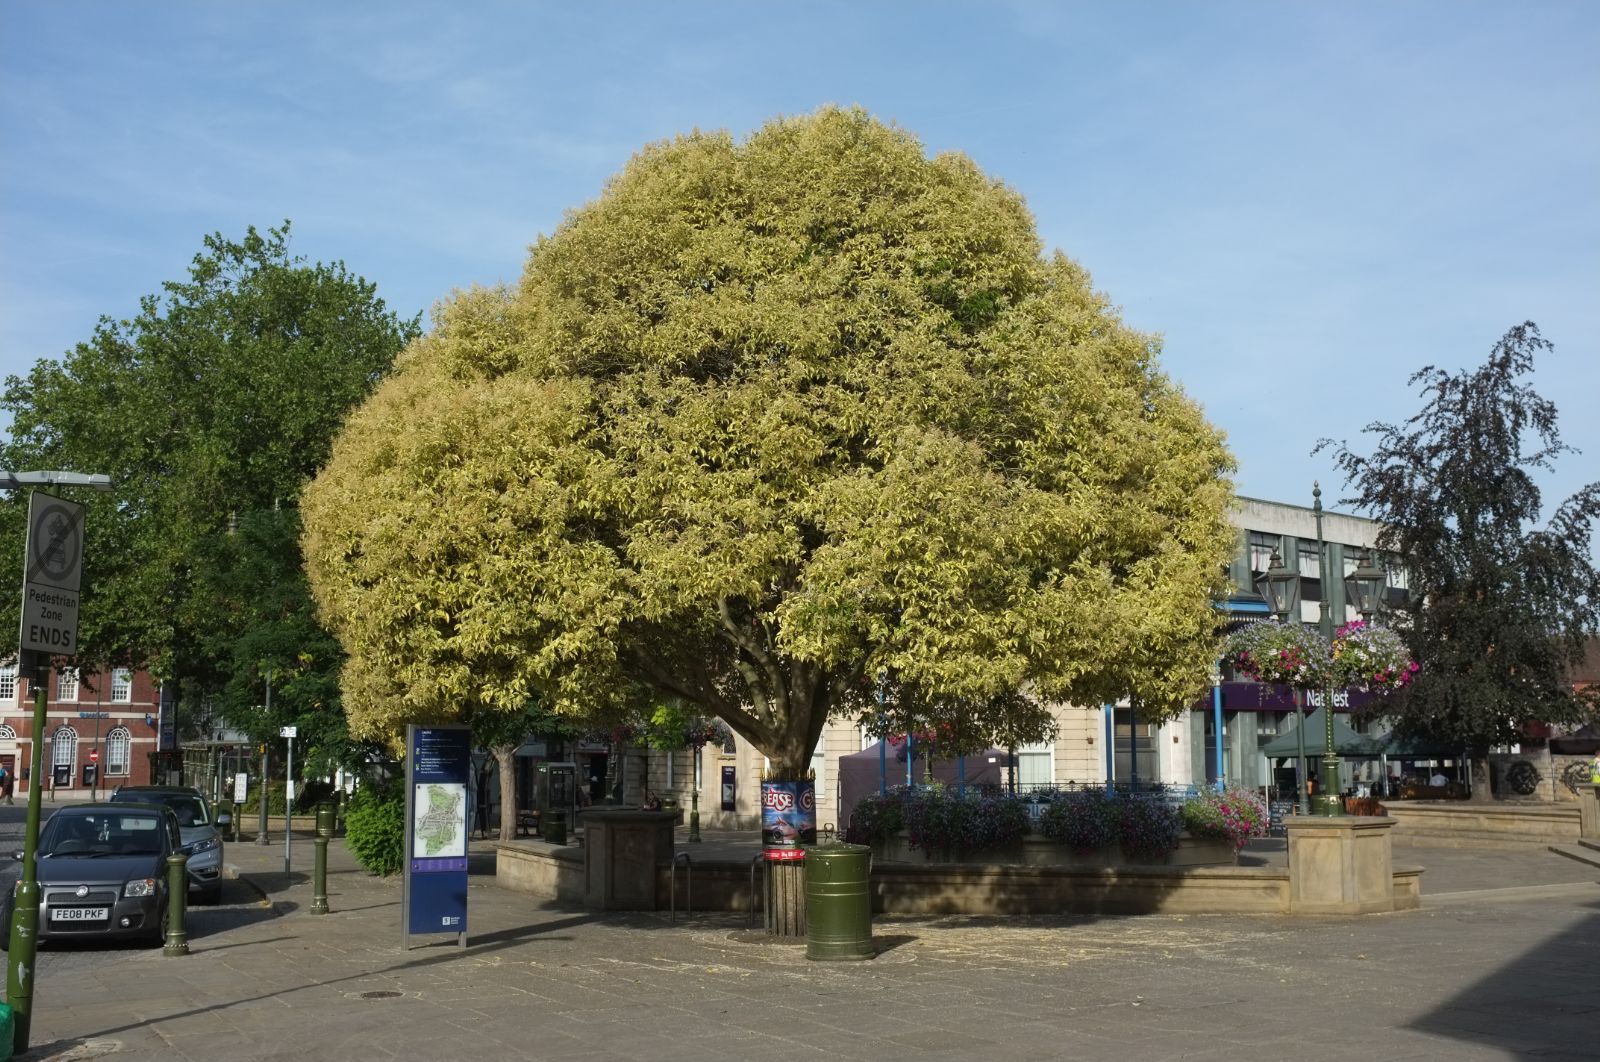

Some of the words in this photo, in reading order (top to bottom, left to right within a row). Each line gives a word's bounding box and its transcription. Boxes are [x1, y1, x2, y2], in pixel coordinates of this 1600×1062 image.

[29, 588, 76, 609] Pedestrian
[40, 606, 63, 621] Zone
[30, 624, 71, 647] ENDS
[56, 909, 82, 919] FE08
[84, 909, 104, 918] PKF
